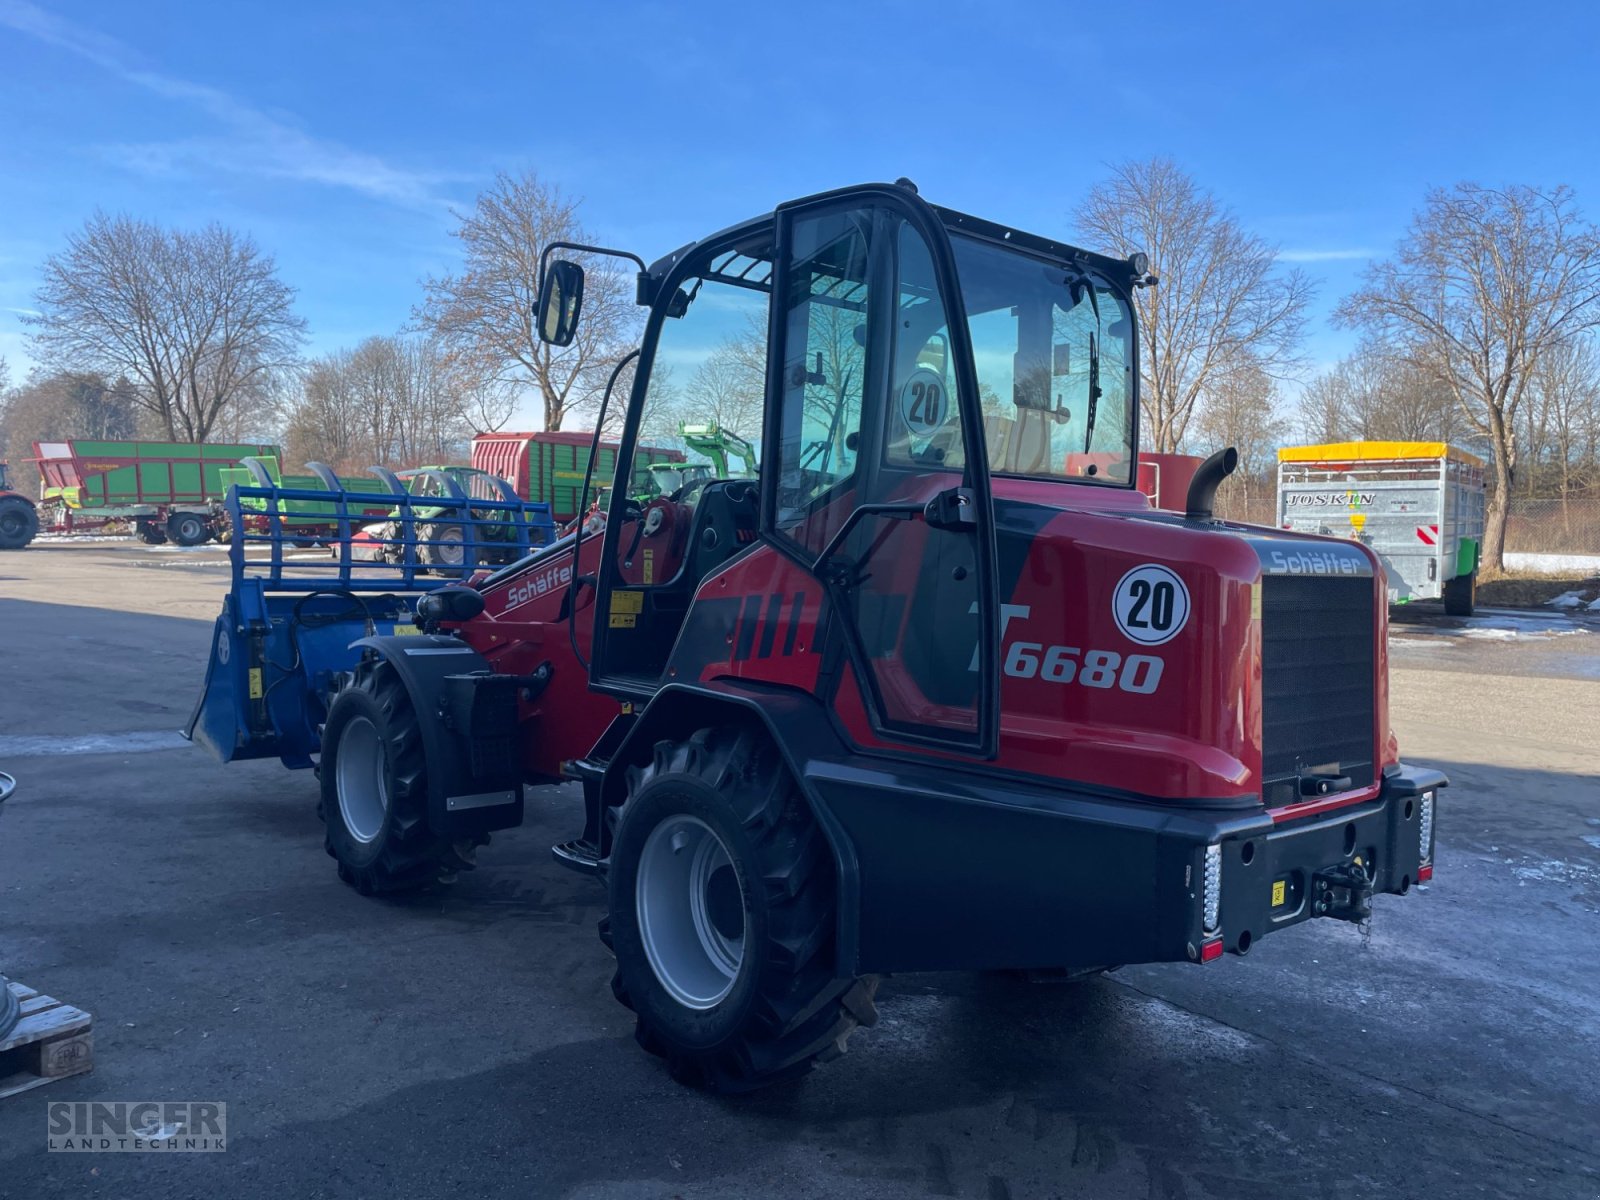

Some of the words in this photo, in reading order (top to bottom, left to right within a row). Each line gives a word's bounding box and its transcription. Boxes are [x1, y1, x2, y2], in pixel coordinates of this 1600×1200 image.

[909, 381, 940, 426] 20
[1286, 494, 1376, 507] JOSKIN
[1269, 550, 1361, 574] Schäffer
[1127, 579, 1175, 631] 20
[1004, 641, 1165, 694] 6680
